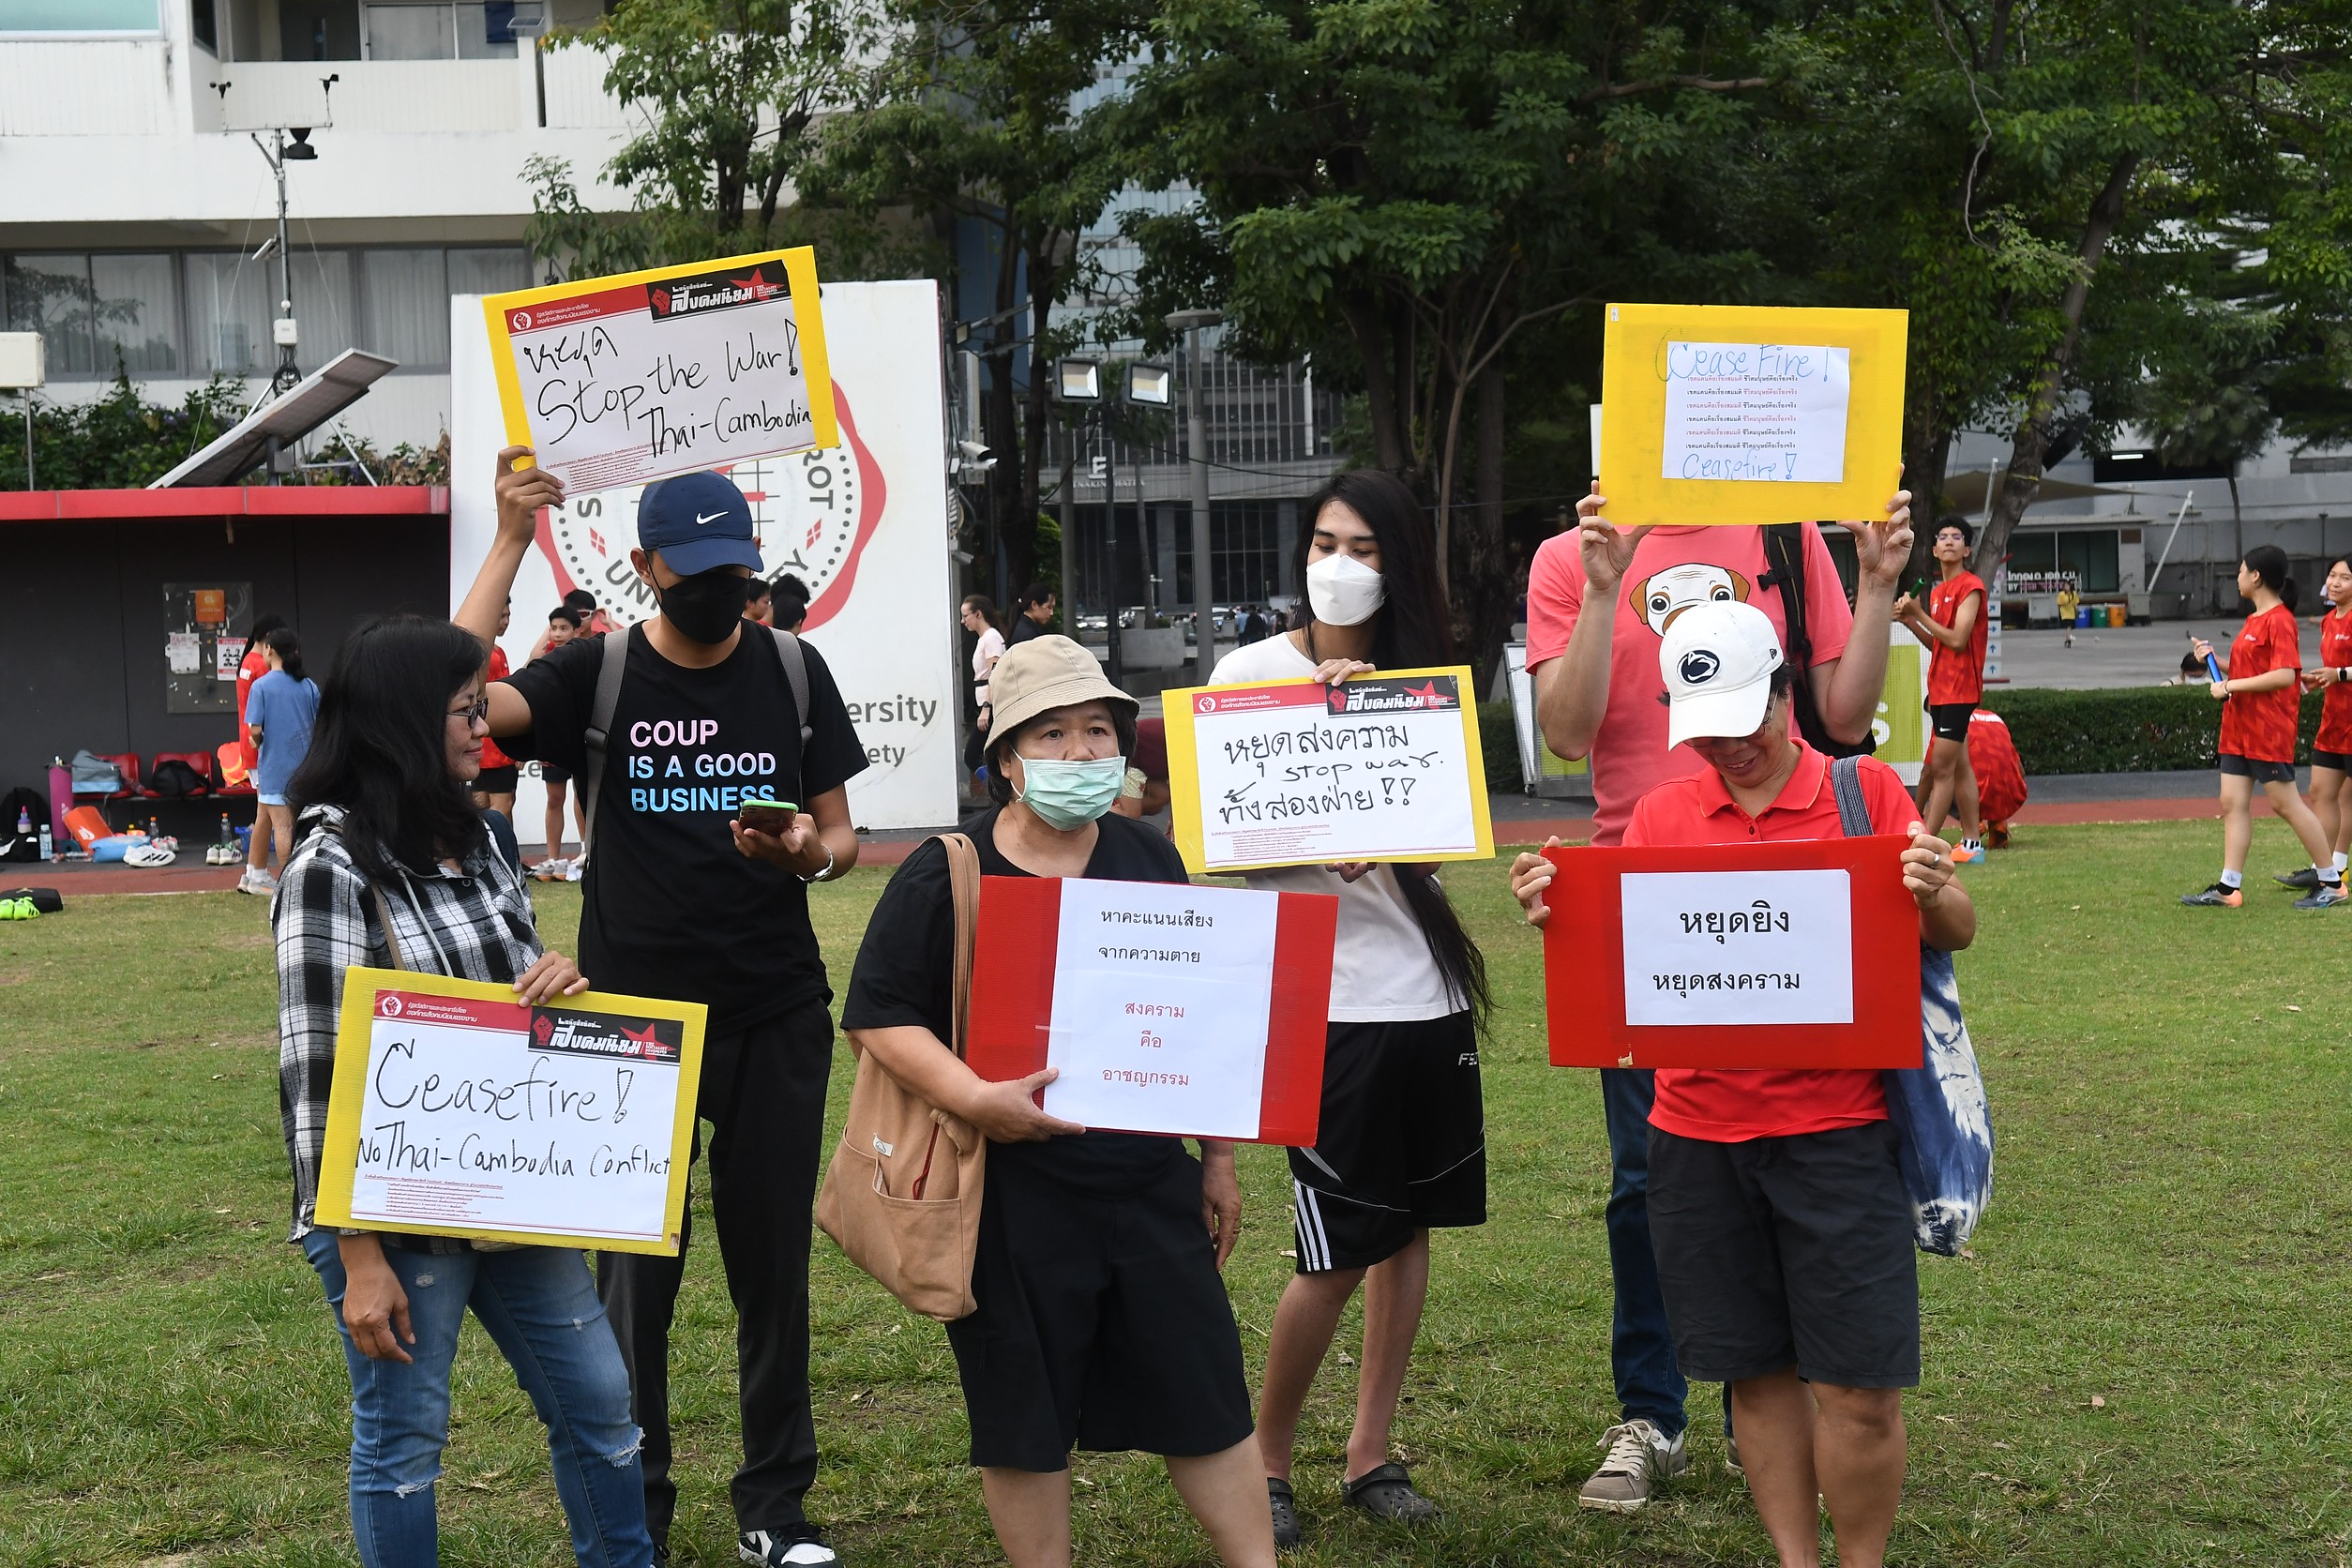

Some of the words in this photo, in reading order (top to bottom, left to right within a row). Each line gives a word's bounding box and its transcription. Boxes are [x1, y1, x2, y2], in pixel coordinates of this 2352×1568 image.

[537, 378, 644, 445] Stop
[646, 353, 709, 396] the
[845, 694, 937, 728] ersity
[629, 719, 719, 747] COUP
[628, 755, 655, 778] IS
[664, 754, 685, 778] A
[694, 752, 776, 777] GOOD
[631, 784, 776, 813] BUSINESS
[1100, 909, 1214, 927] หาคะแนนเสียง
[1679, 899, 1790, 945] หยุดยิง
[1098, 946, 1201, 963] จากความตาย
[1652, 970, 1801, 999] หยุดสงคราม
[1124, 1002, 1184, 1018] สงคราม
[1140, 1030, 1162, 1048] คือ
[590, 1144, 671, 1178] Conflict
